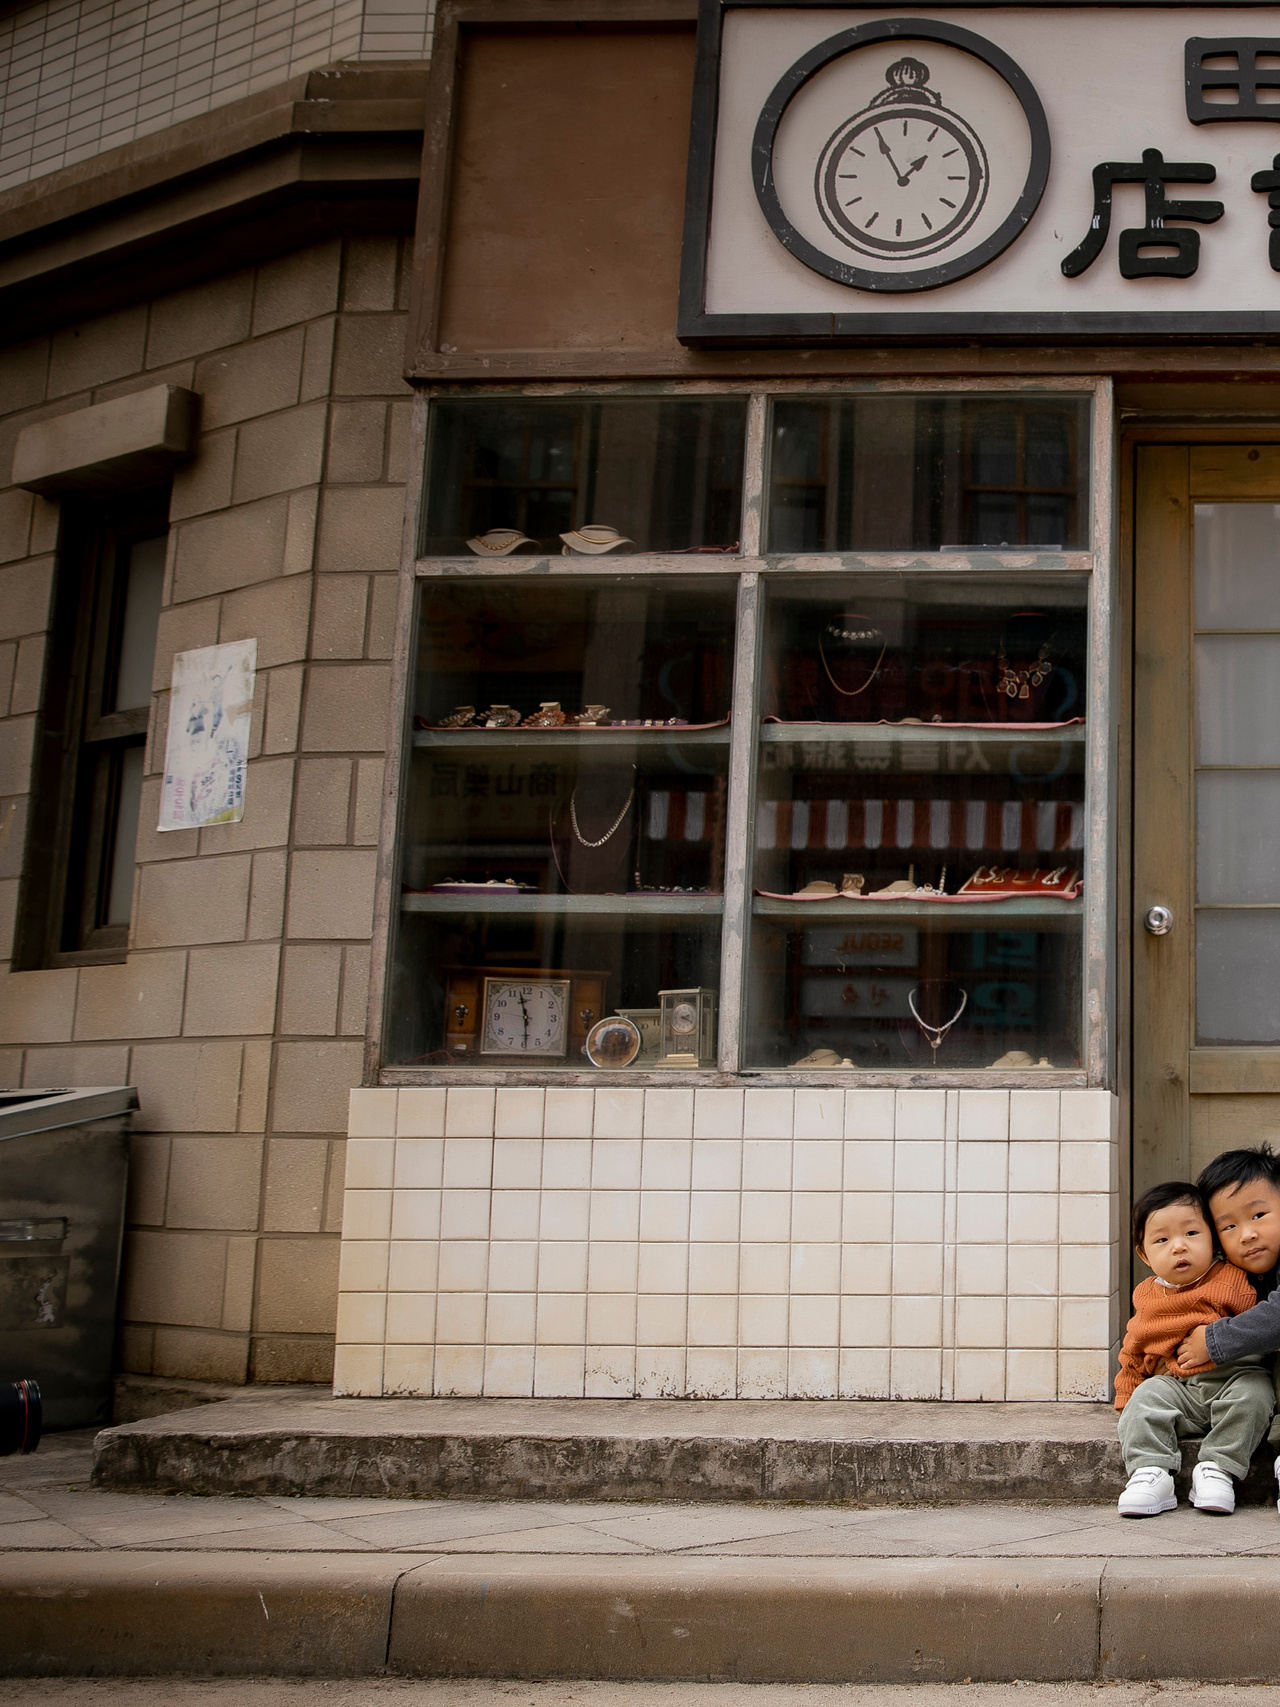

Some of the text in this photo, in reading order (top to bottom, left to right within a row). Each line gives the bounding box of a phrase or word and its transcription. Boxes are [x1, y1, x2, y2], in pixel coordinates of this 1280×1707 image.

[508, 990, 517, 998] 11
[522, 987, 533, 995] 12
[539, 991, 544, 999] 1
[497, 1000, 507, 1008] 10
[548, 1001, 554, 1009] 2
[494, 1013, 500, 1021] 9
[550, 1014, 557, 1023] 3
[497, 1027, 504, 1035] 8
[545, 1029, 551, 1037] 4
[508, 1037, 514, 1045] 7
[534, 1038, 541, 1046] 5
